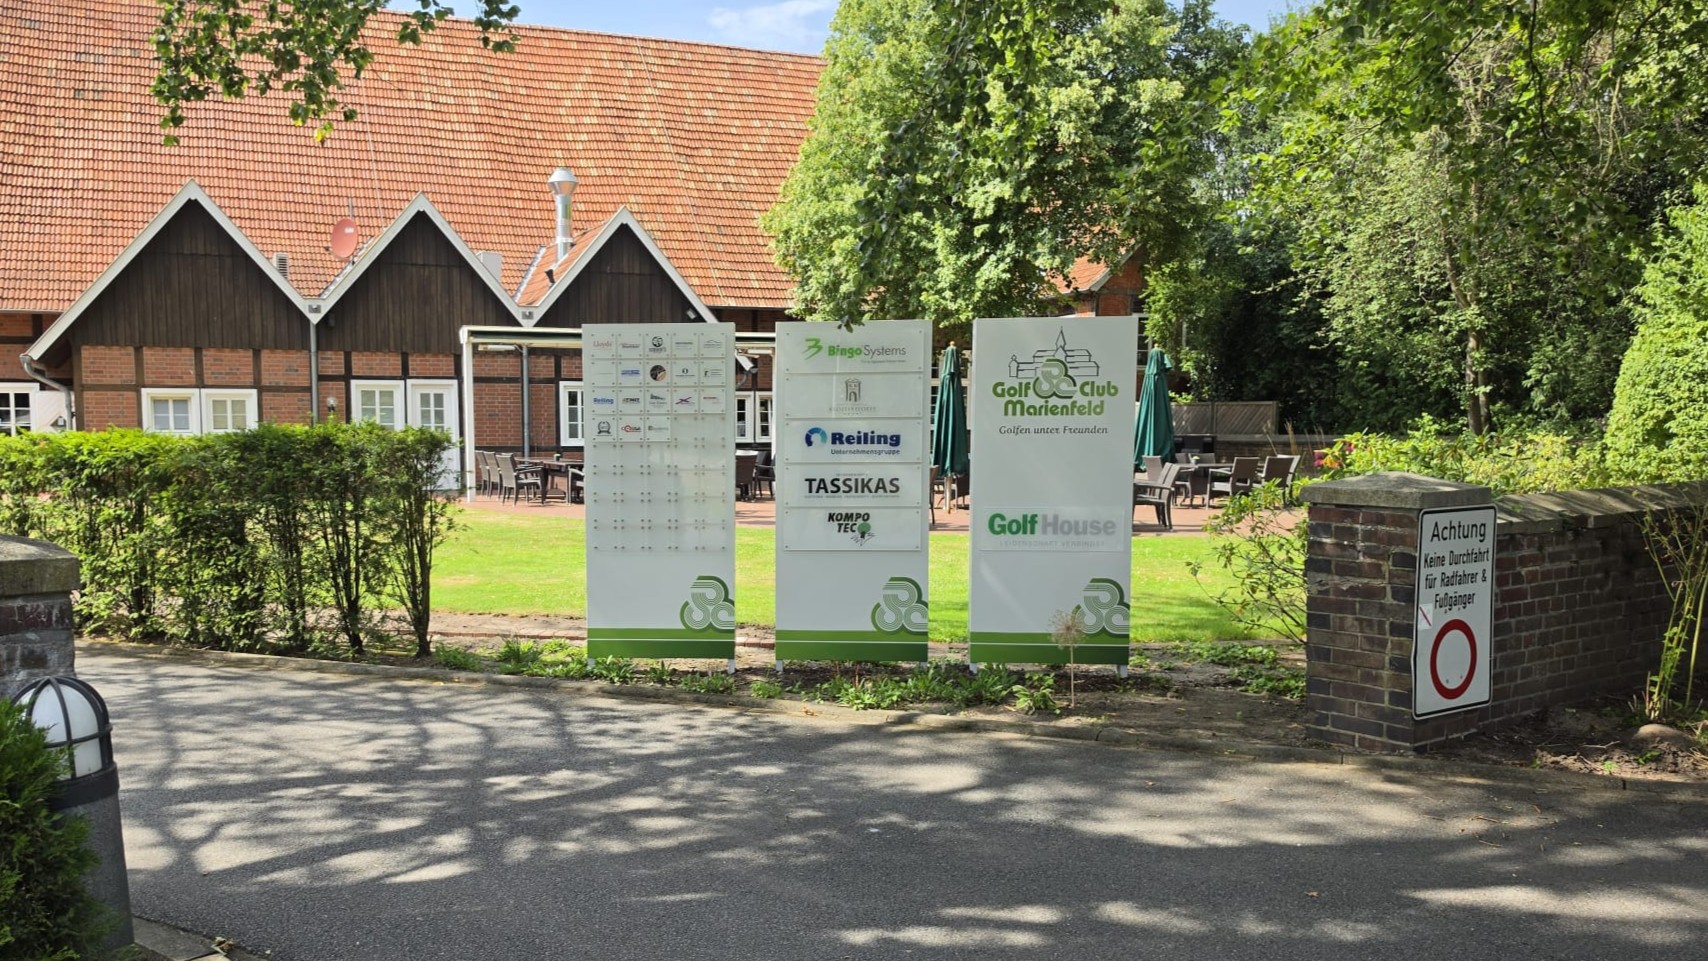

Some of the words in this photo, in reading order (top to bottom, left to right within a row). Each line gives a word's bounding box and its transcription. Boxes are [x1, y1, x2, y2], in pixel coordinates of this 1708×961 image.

[992, 381, 1031, 398] Golf
[1079, 380, 1119, 397] Club
[1003, 399, 1105, 417] Marienfeld
[831, 430, 901, 447] Reiling
[999, 425, 1031, 436] Golfen
[1034, 426, 1059, 434] unter
[1063, 425, 1108, 434] Freunden
[804, 477, 900, 494] TASSIKAS
[827, 512, 870, 523] KOMPO
[837, 523, 857, 533] TEC
[1430, 520, 1486, 543] Achtung
[1423, 552, 1446, 569] Keine
[1448, 547, 1490, 566] Durchfahrt
[1424, 573, 1437, 590] für
[1440, 569, 1479, 588] Radfahrer
[1480, 568, 1487, 583] &
[1434, 591, 1476, 611] Fußgänger
